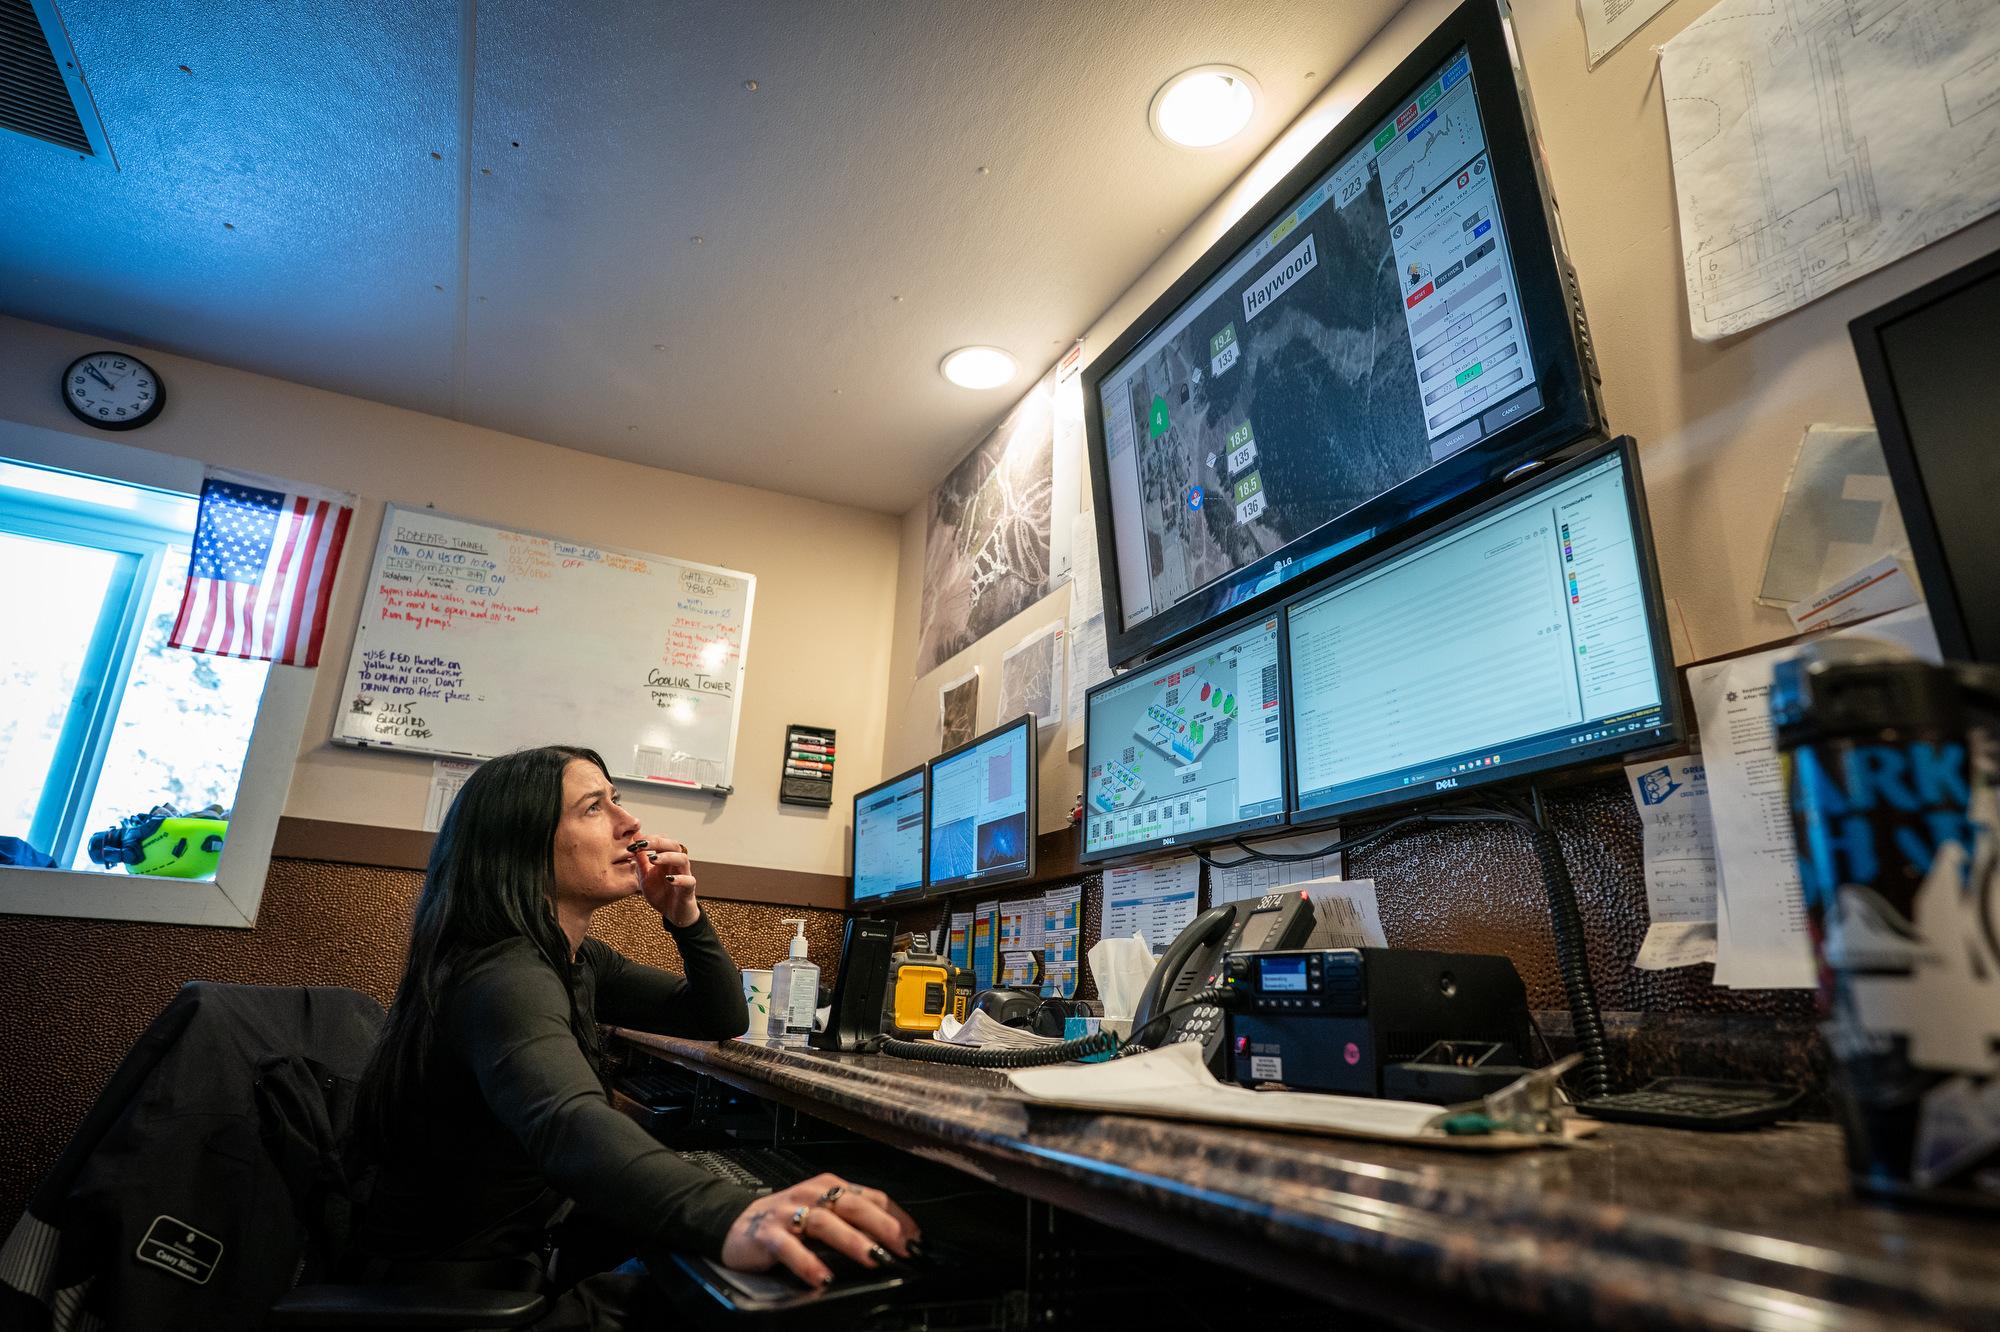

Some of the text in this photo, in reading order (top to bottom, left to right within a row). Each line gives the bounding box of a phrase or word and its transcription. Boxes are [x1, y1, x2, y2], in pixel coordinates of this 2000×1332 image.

[1342, 176, 1362, 202] 223
[1247, 244, 1313, 313] Haywood
[1413, 289, 1427, 301] RESET
[1214, 329, 1232, 351] 19.2
[98, 360, 107, 369] 11
[113, 360, 127, 370] 12
[1218, 350, 1233, 369] 133
[75, 375, 86, 385] 9
[137, 379, 148, 388] 2
[76, 388, 86, 398] 8
[137, 391, 149, 401] 3
[85, 400, 95, 408] 7
[129, 403, 140, 411] 4
[98, 407, 110, 416] 6
[115, 407, 127, 416] 5
[1501, 404, 1520, 417] CANCEL
[1230, 426, 1248, 448] 18.9
[1445, 435, 1465, 447] VALIDATE
[1234, 448, 1250, 467] 135
[1239, 477, 1257, 498] 18.5
[1242, 499, 1259, 518] 136
[396, 526, 448, 545] ROBERTS
[452, 537, 488, 552] TUNNEL
[416, 548, 434, 560] ON
[562, 559, 585, 568] OFF
[490, 575, 506, 583] ON
[681, 570, 705, 584] GATE
[466, 585, 500, 597] OPEN
[431, 603, 441, 613] be
[444, 607, 468, 620] open
[390, 652, 410, 663] RED
[414, 655, 446, 667] Handle
[448, 661, 461, 670] on
[358, 671, 371, 680] TO
[374, 672, 408, 685] DRAIN
[648, 668, 732, 692] COOLING TOWER
[361, 682, 390, 693] DRAIN
[393, 686, 414, 695] ONTO
[404, 728, 433, 738] CODE
[1435, 778, 1458, 790] DELL
[1162, 837, 1175, 845] DELL
[1255, 894, 1284, 910] 3874
